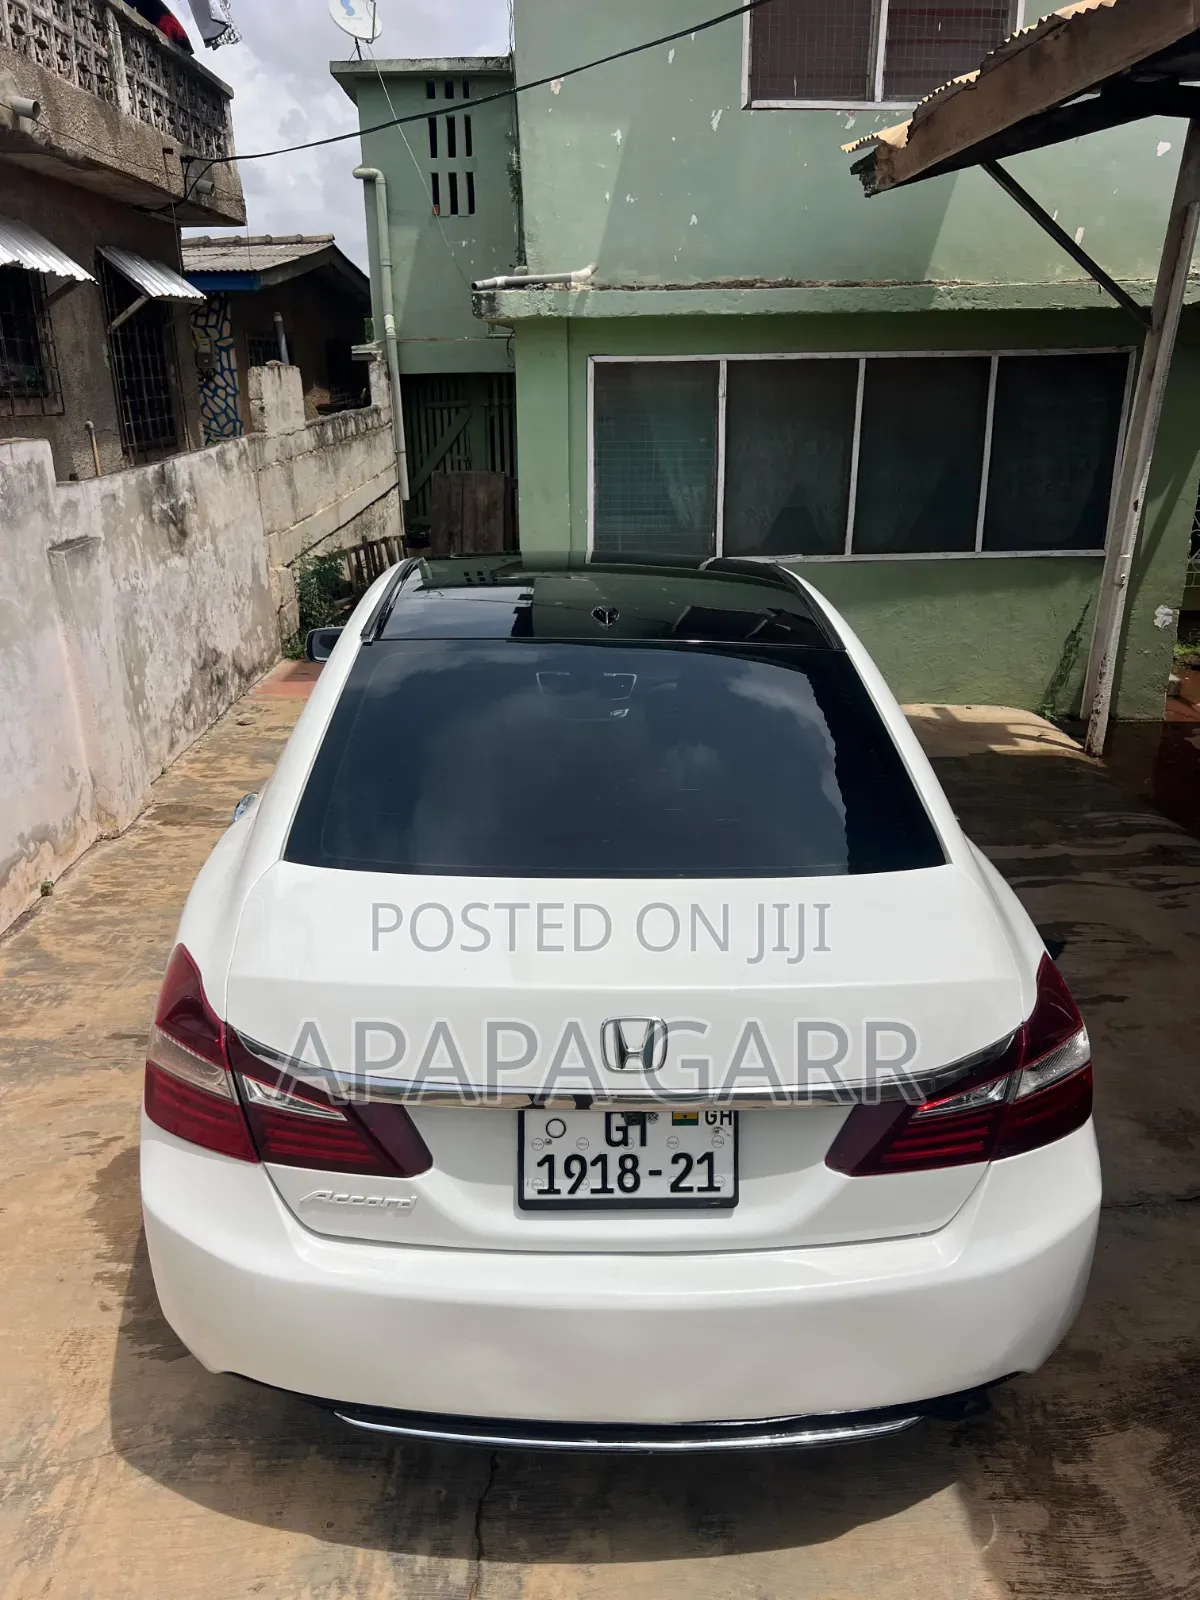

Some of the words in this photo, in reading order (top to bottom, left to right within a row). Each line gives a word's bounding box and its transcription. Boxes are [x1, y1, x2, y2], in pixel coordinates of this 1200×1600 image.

[705, 1110, 733, 1126] GH
[536, 1151, 721, 1195] 1918-21
[299, 1190, 417, 1209] Accord
